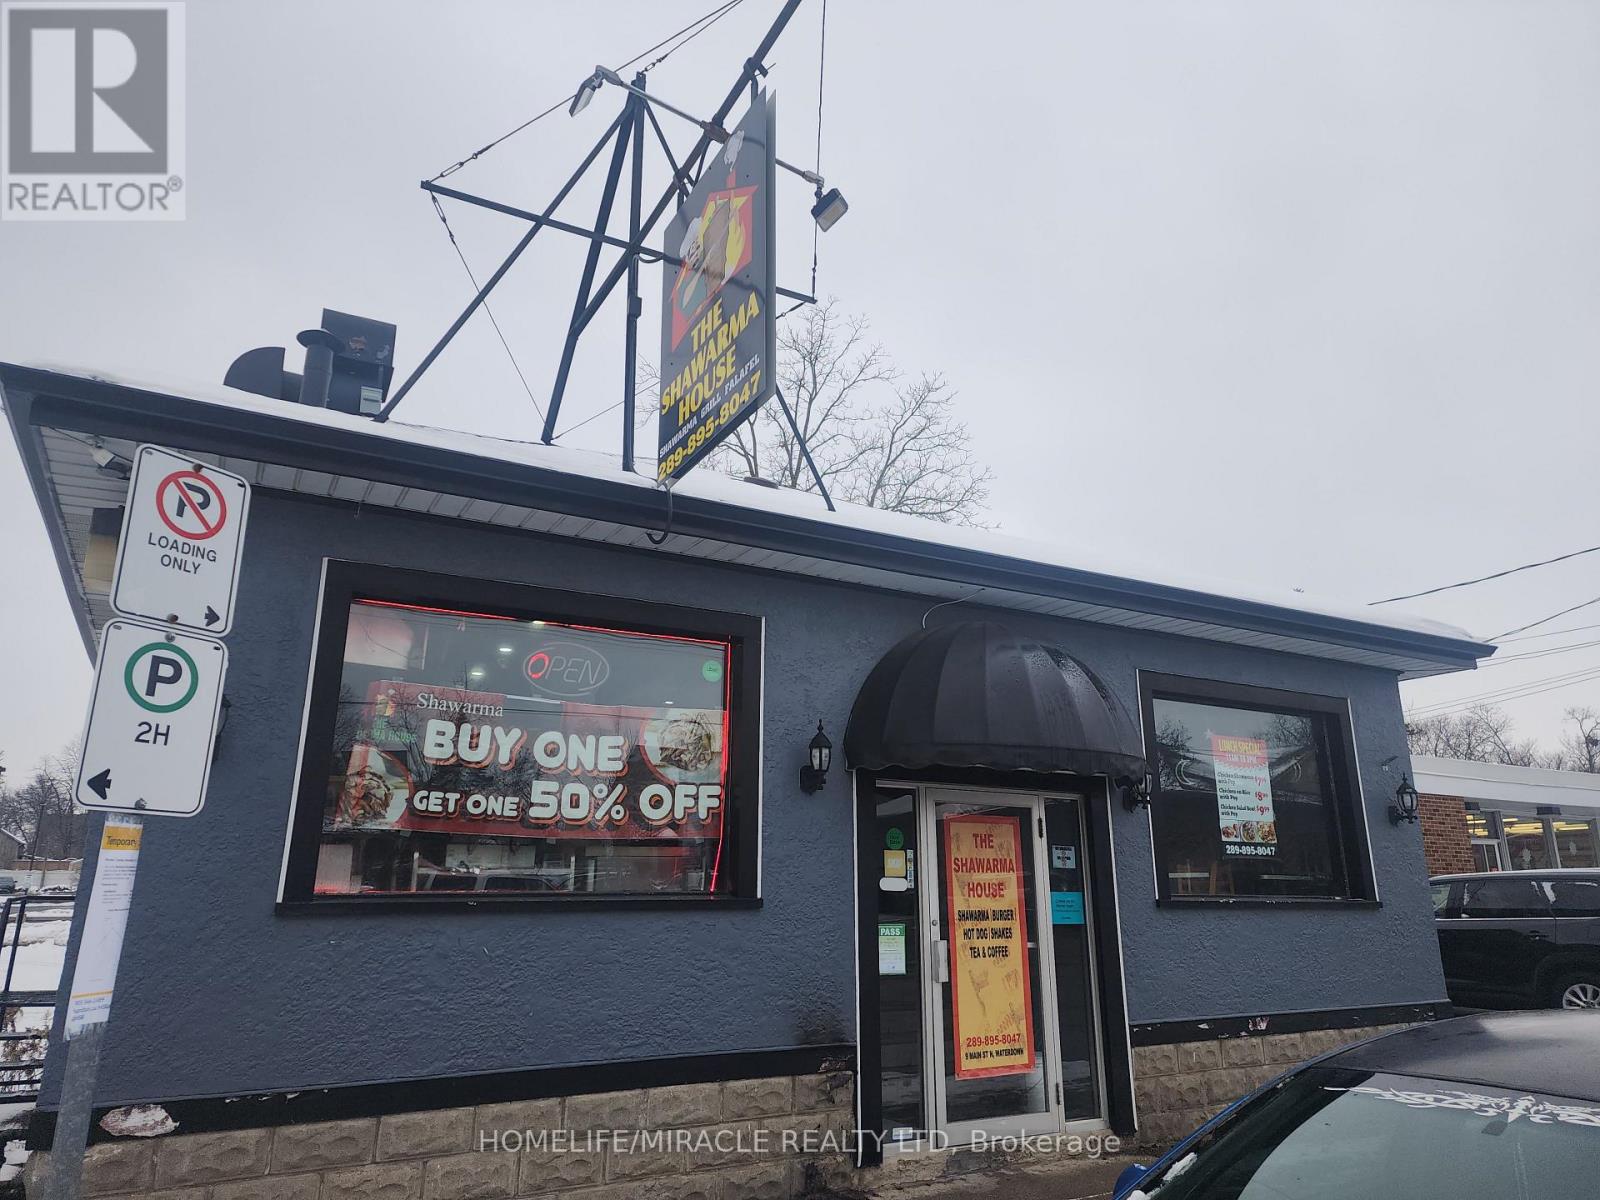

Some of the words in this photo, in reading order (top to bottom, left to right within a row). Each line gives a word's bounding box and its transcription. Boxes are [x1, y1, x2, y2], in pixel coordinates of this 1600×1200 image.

[691, 298, 723, 352] THE
[661, 292, 760, 415] SHAWARMA
[678, 344, 736, 427] HOUSE
[659, 416, 698, 458] SHAWARMA
[700, 394, 722, 418] GRILL
[724, 352, 760, 396] FALAFEL
[657, 370, 761, 482] 289-895-8047
[148, 532, 217, 562] LOADING
[160, 554, 201, 575] ONLY
[528, 652, 601, 685] OPEN
[416, 692, 504, 717] Shawarma
[134, 721, 170, 746] 2H
[423, 718, 525, 769] BUY
[533, 731, 627, 774] ONE
[413, 790, 462, 815] GET
[466, 795, 520, 817] ONE
[528, 780, 628, 823] 50%
[639, 784, 722, 822] OFF
[972, 833, 994, 849] THE
[1225, 844, 1276, 856] 289-895-8047
[953, 857, 1015, 873] SHAWARMA
[967, 882, 1004, 898] HOUSE
[957, 909, 989, 921] SHAWARMA
[992, 909, 1014, 921] BURGER
[880, 927, 901, 936] PASS
[963, 927, 975, 940] HOT
[976, 927, 988, 940] DOG
[990, 927, 1013, 940] SHAKES
[969, 946, 981, 958] TEA
[982, 946, 986, 957] &
[987, 945, 1009, 958] COFFEE
[966, 1033, 1021, 1047] 289-895-8047
[969, 1050, 982, 1060] MAIN
[982, 1050, 989, 1059] ST
[995, 1047, 1024, 1057] WATERDOWN
